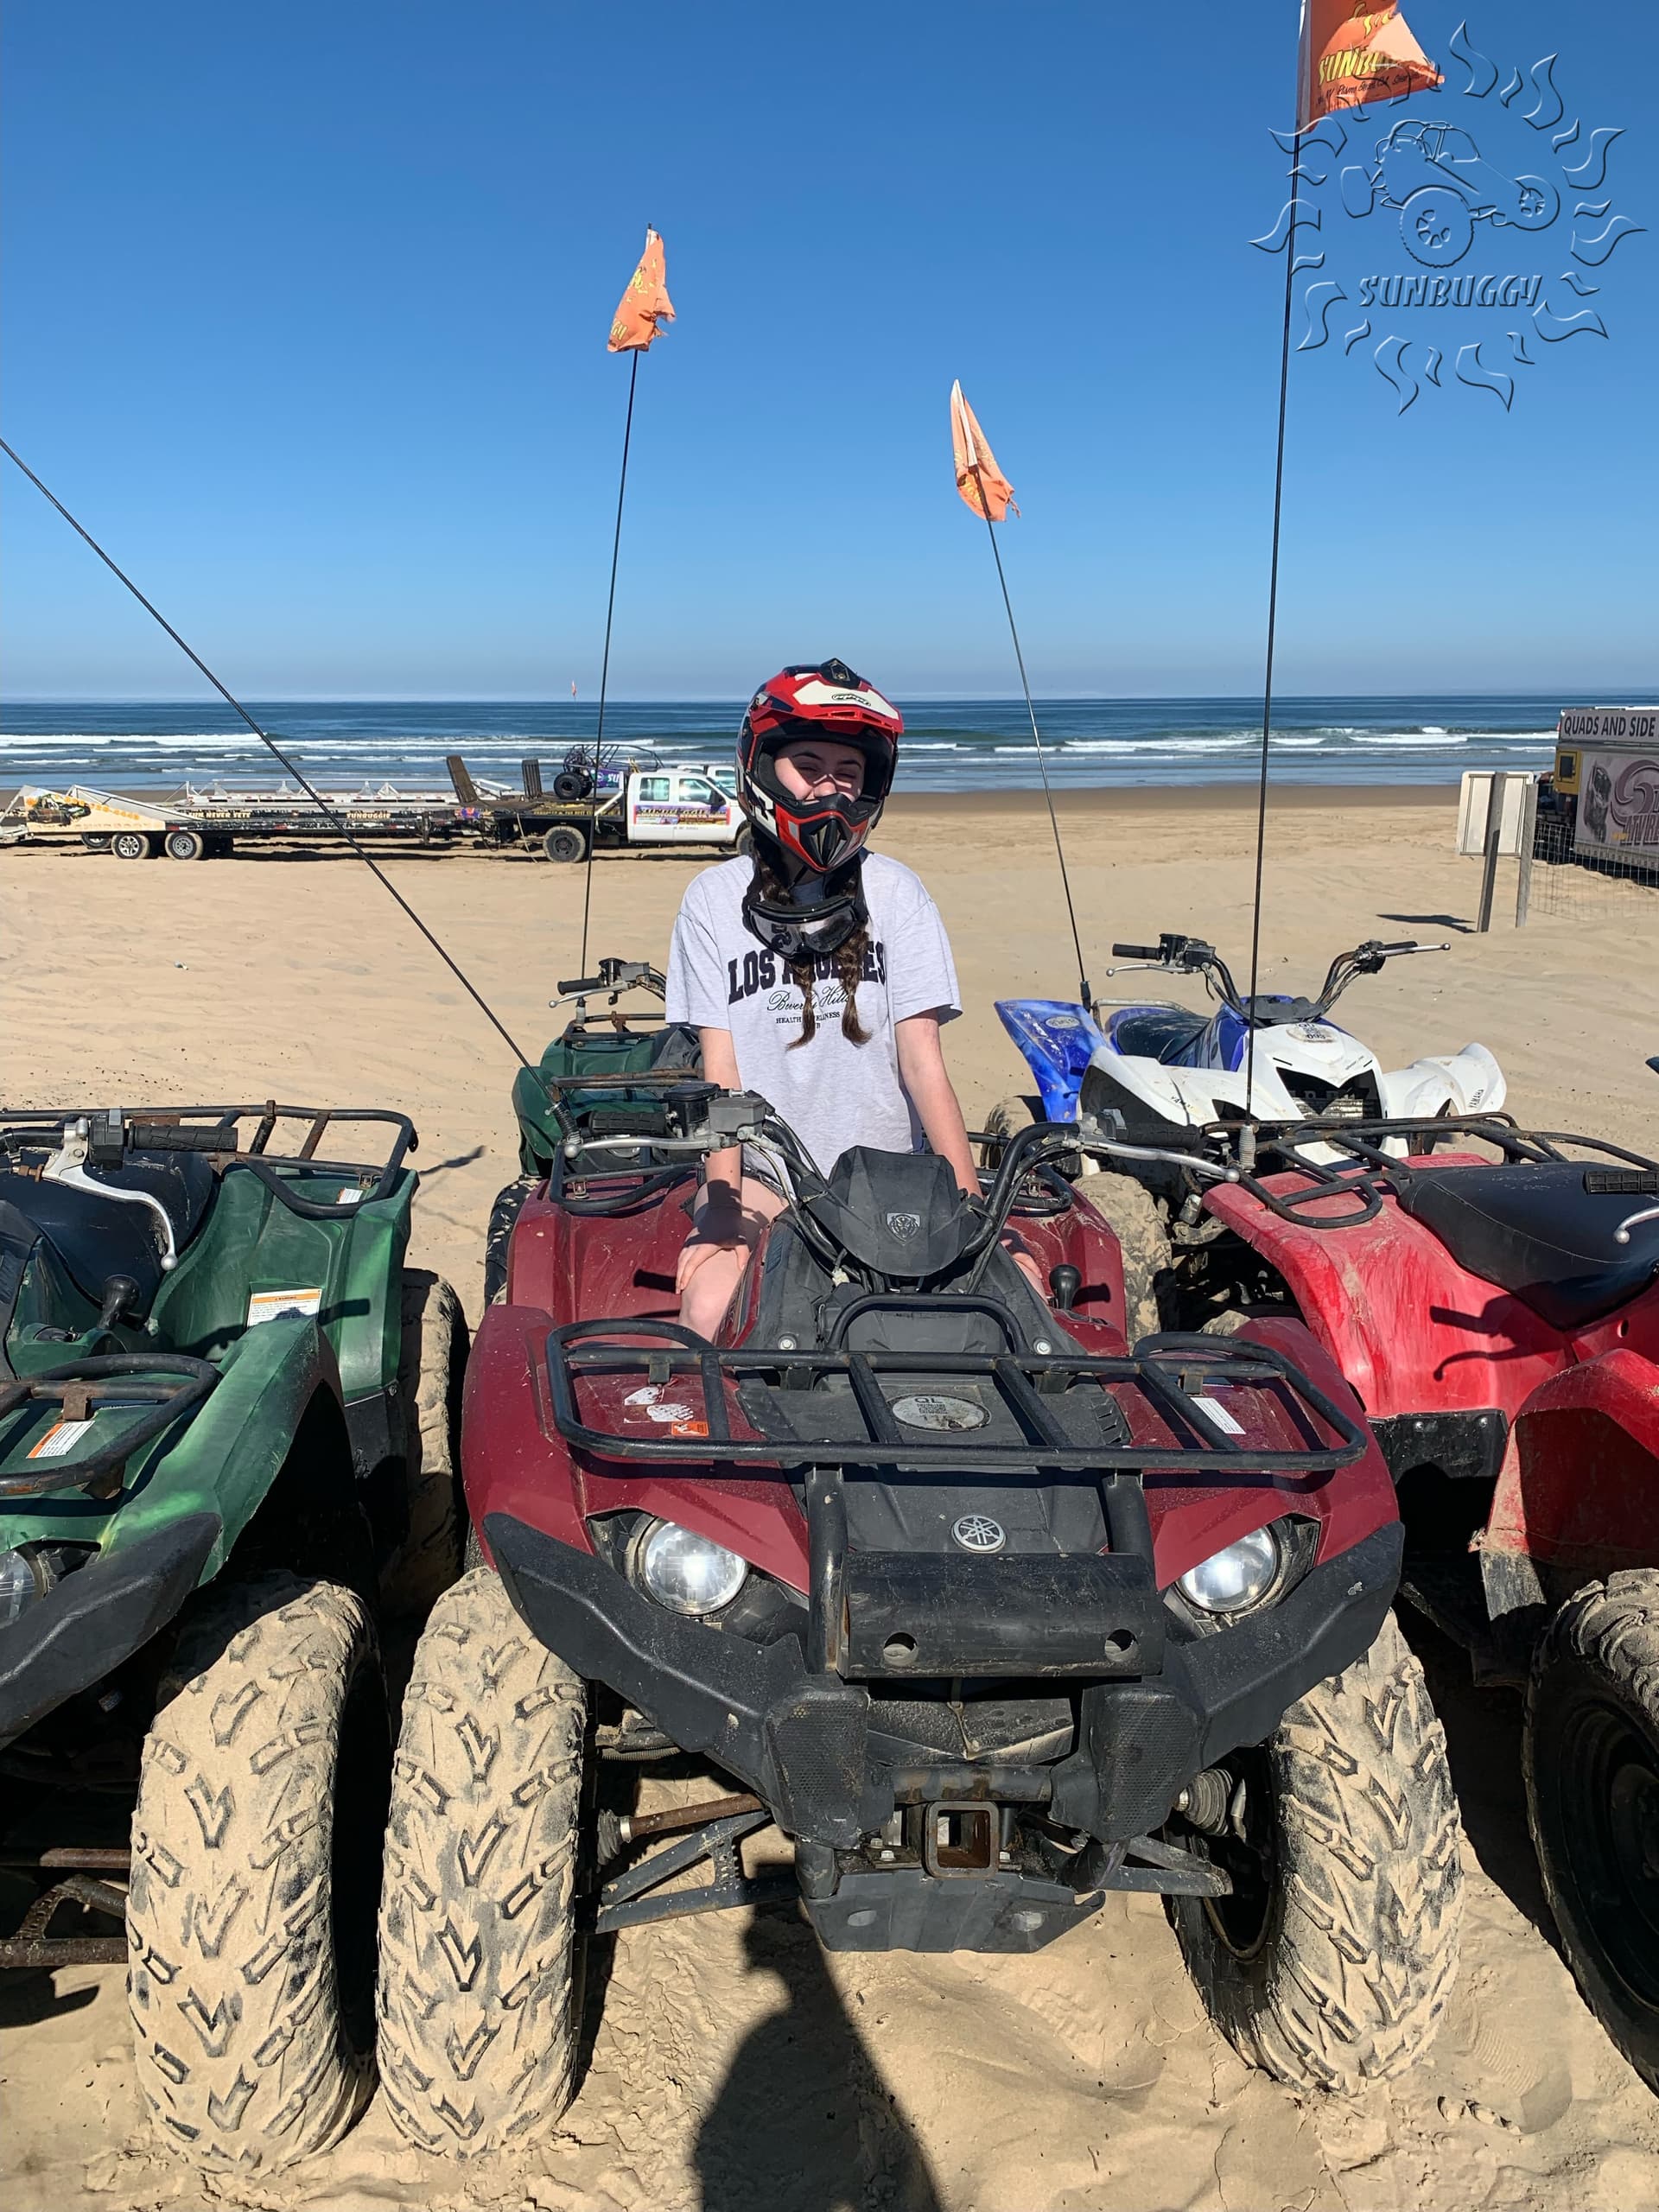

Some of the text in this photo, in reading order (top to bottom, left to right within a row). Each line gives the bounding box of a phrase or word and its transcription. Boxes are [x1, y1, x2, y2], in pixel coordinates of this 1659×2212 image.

[1564, 715, 1656, 737] QUADS AND SIDE
[728, 950, 776, 1005] LOS
[816, 1011, 841, 1021] ELLNESS
